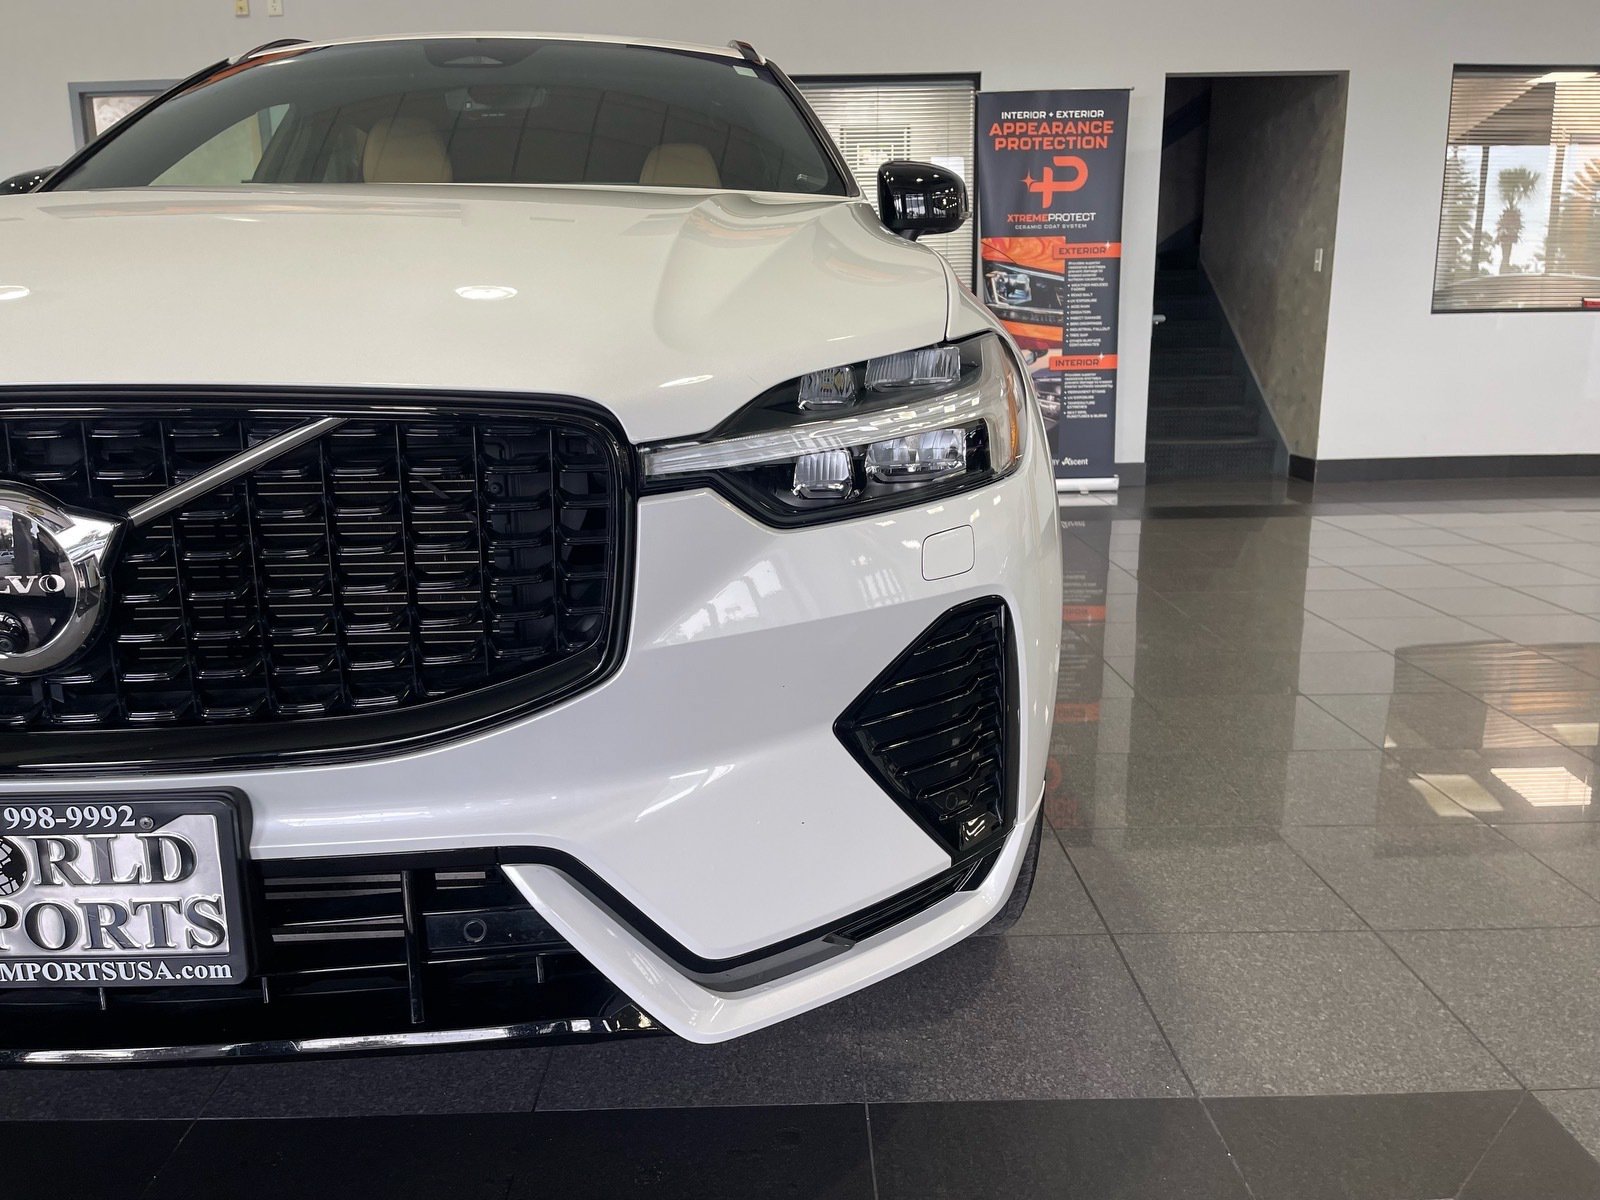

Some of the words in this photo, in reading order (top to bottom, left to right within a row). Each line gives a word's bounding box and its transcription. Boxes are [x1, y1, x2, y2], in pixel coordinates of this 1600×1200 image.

[1001, 111, 1046, 120] INTERIOR
[1056, 110, 1105, 119] EXTERIOR
[989, 121, 1114, 136] APPEARANCE
[995, 136, 1108, 151] PROTECTION
[1007, 212, 1097, 223] XTREMEPROTECT
[1058, 246, 1107, 256] EXTERIOR
[1055, 358, 1100, 367] INTERIOR
[1061, 457, 1089, 466] Ascent
[3, 805, 137, 830] 998-9992
